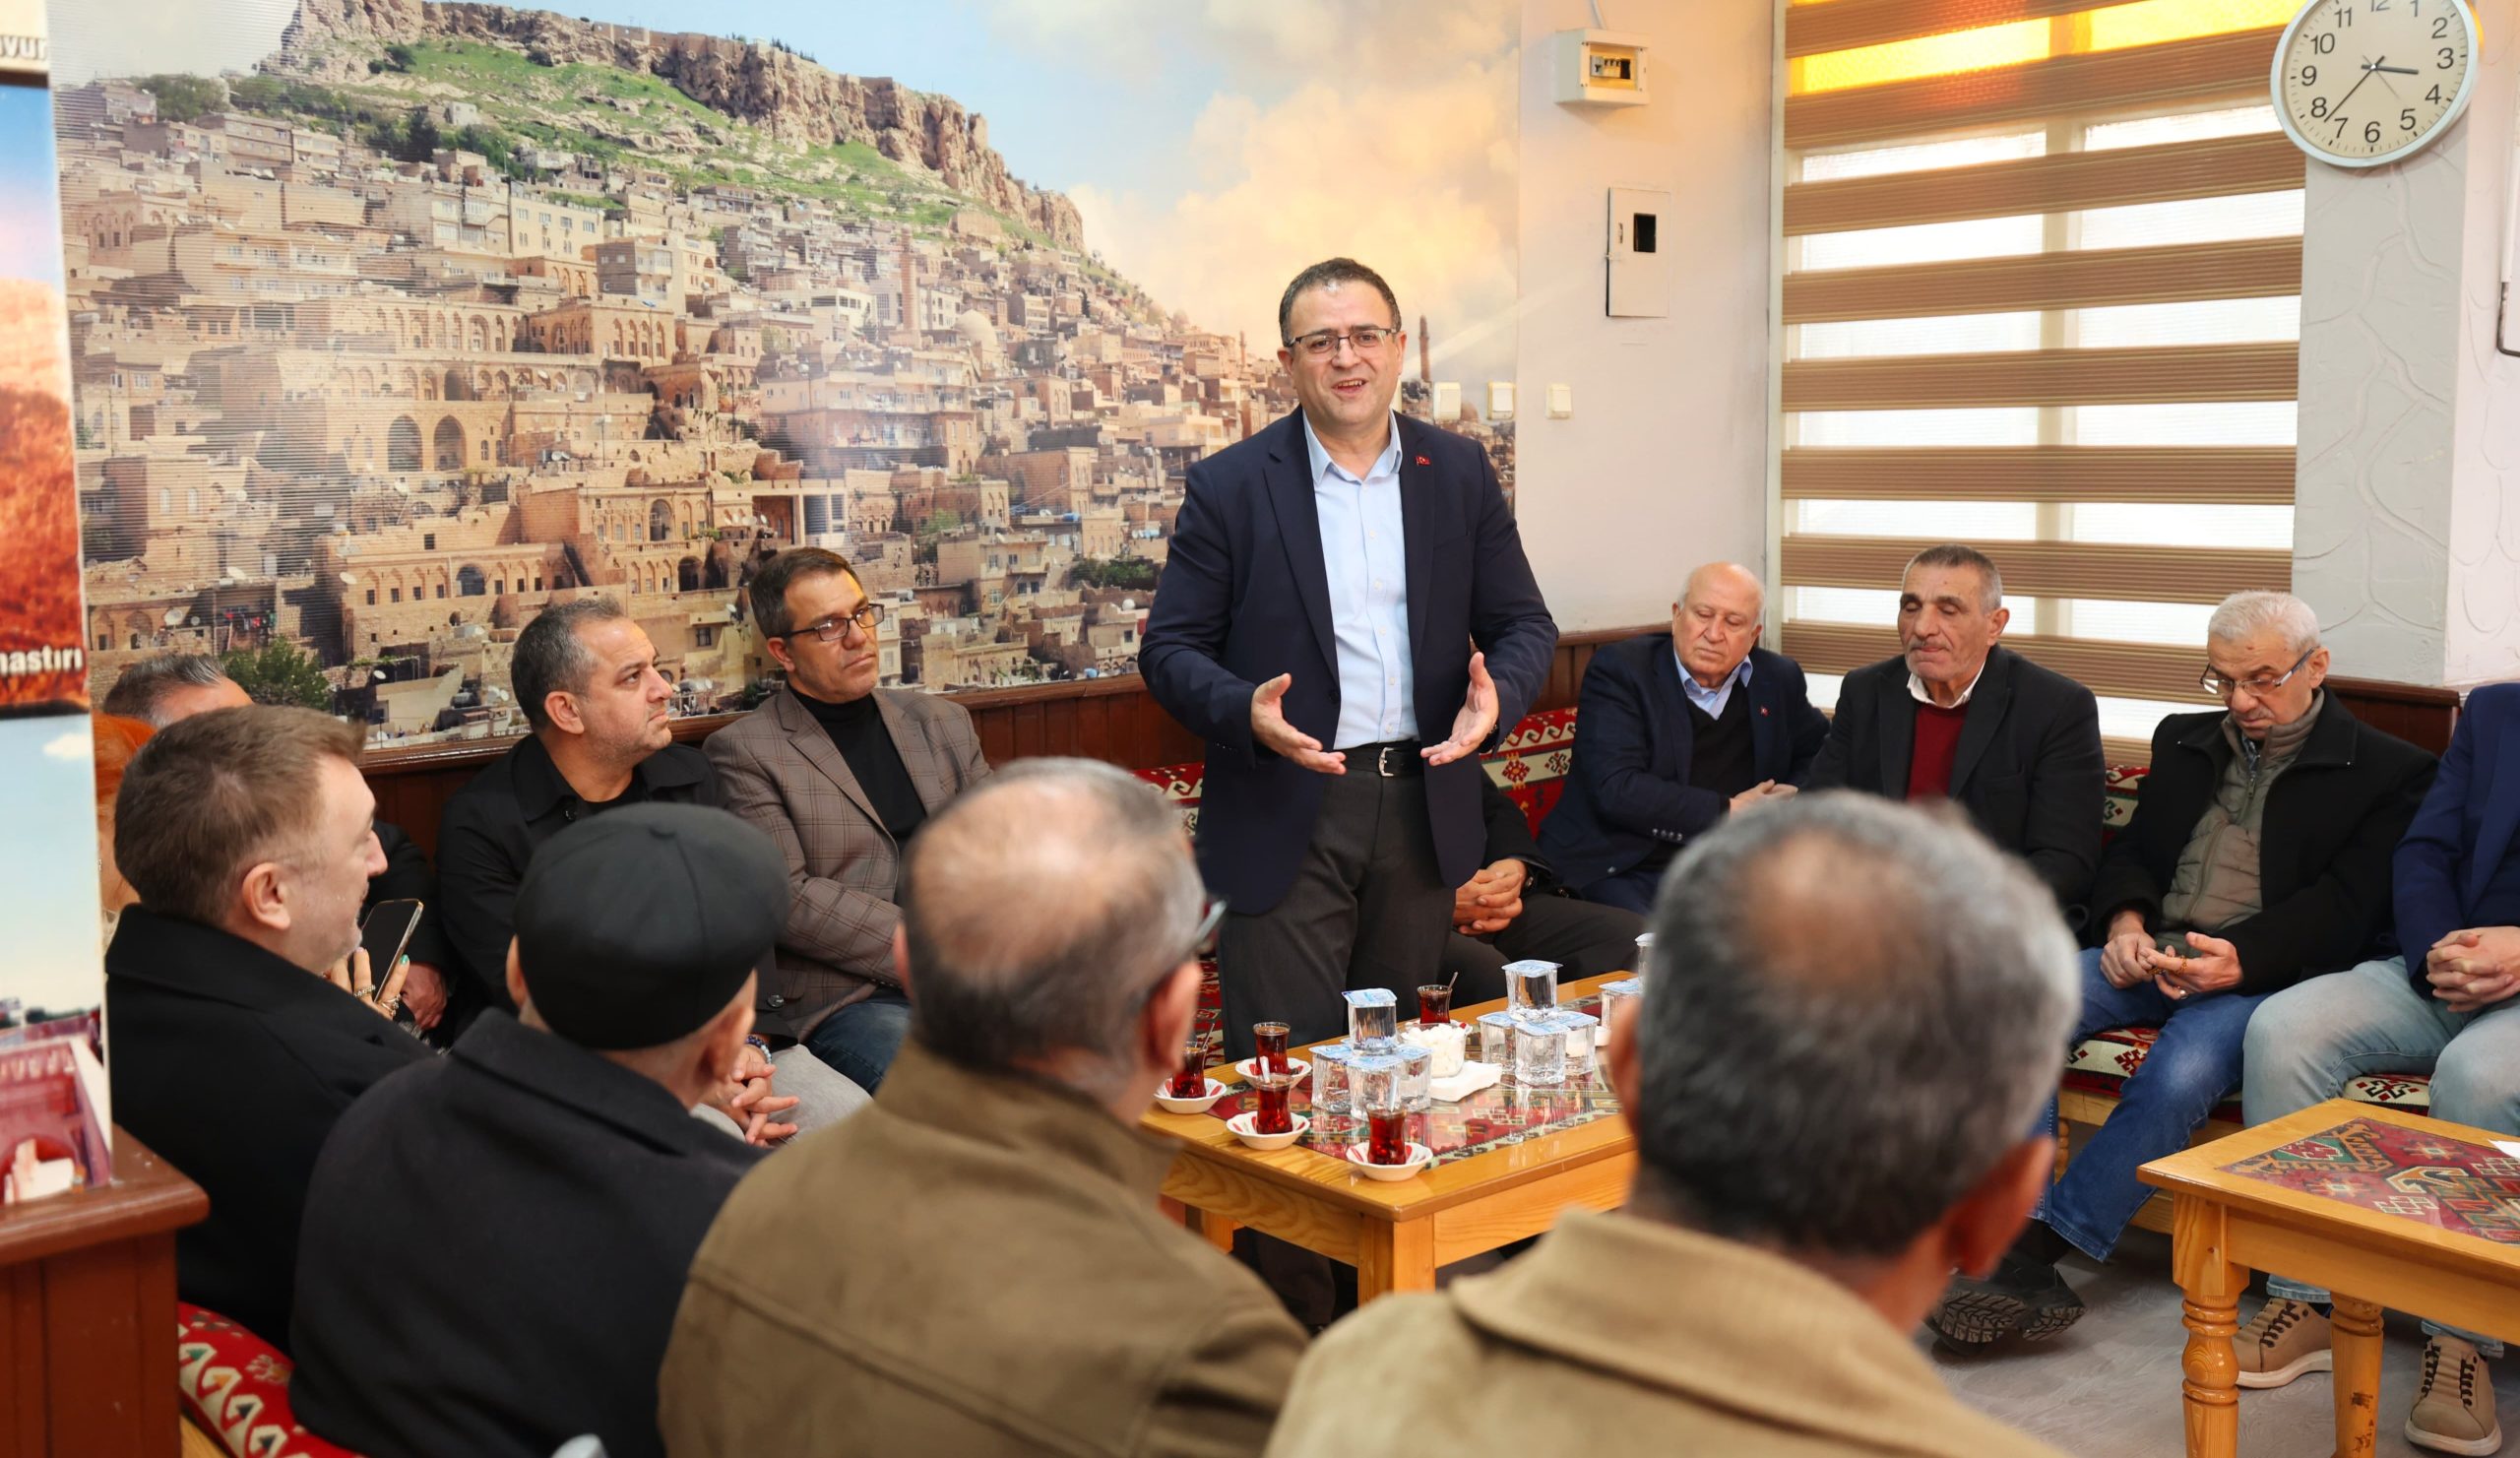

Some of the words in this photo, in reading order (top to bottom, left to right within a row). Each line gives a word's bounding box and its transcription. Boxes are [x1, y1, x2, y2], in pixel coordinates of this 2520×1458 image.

[2334, 8, 2353, 28] 11
[2410, 0, 2419, 17] 1
[2431, 17, 2448, 39] 2
[0, 35, 47, 60] vur
[2310, 32, 2335, 54] 10
[2436, 47, 2454, 69] 3
[2301, 65, 2317, 87] 9
[2425, 84, 2442, 105] 4
[2310, 96, 2327, 118] 8
[2334, 117, 2349, 139] 7
[2399, 108, 2417, 131] 5
[2364, 120, 2381, 144] 6
